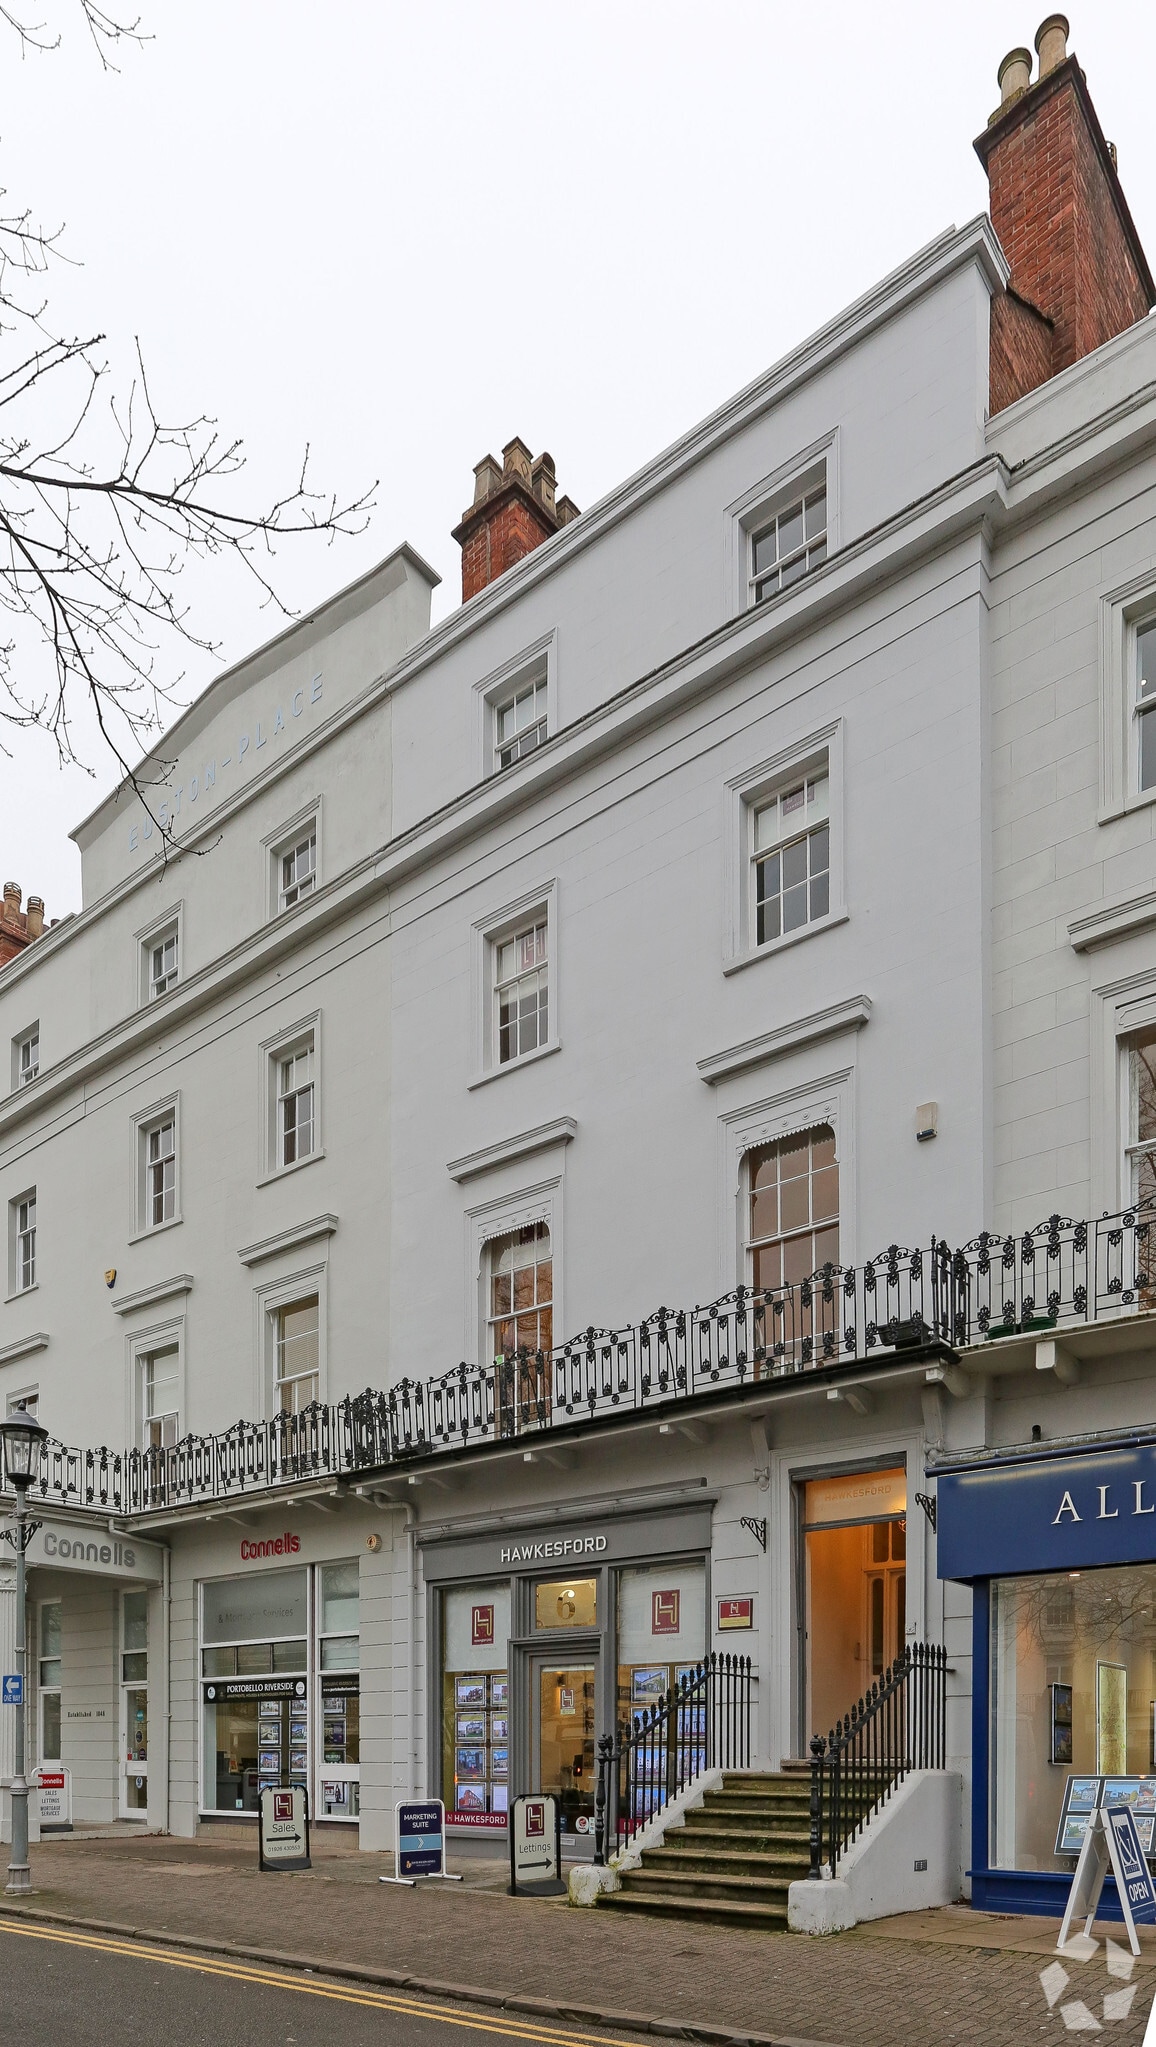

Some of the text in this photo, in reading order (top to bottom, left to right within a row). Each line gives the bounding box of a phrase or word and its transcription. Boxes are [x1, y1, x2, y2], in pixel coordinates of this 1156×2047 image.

[824, 1485, 892, 1502] HAWKESFORD
[1051, 1480, 1155, 1525] ALL
[44, 1532, 136, 1567] Connells
[240, 1532, 301, 1560] Connells
[501, 1535, 606, 1563] HAWKESFORD
[557, 1589, 576, 1620] 6
[226, 1684, 264, 1693] PORTOBELLO
[264, 1682, 295, 1691] RIVERSIDE
[4, 1694, 21, 1702] ONE WAY
[404, 1813, 437, 1821] MARKETING
[454, 1814, 506, 1825] HAWKESFORD
[272, 1823, 296, 1833] Sales
[519, 1842, 551, 1854] Lettings
[1128, 1880, 1149, 1902] OPEN
